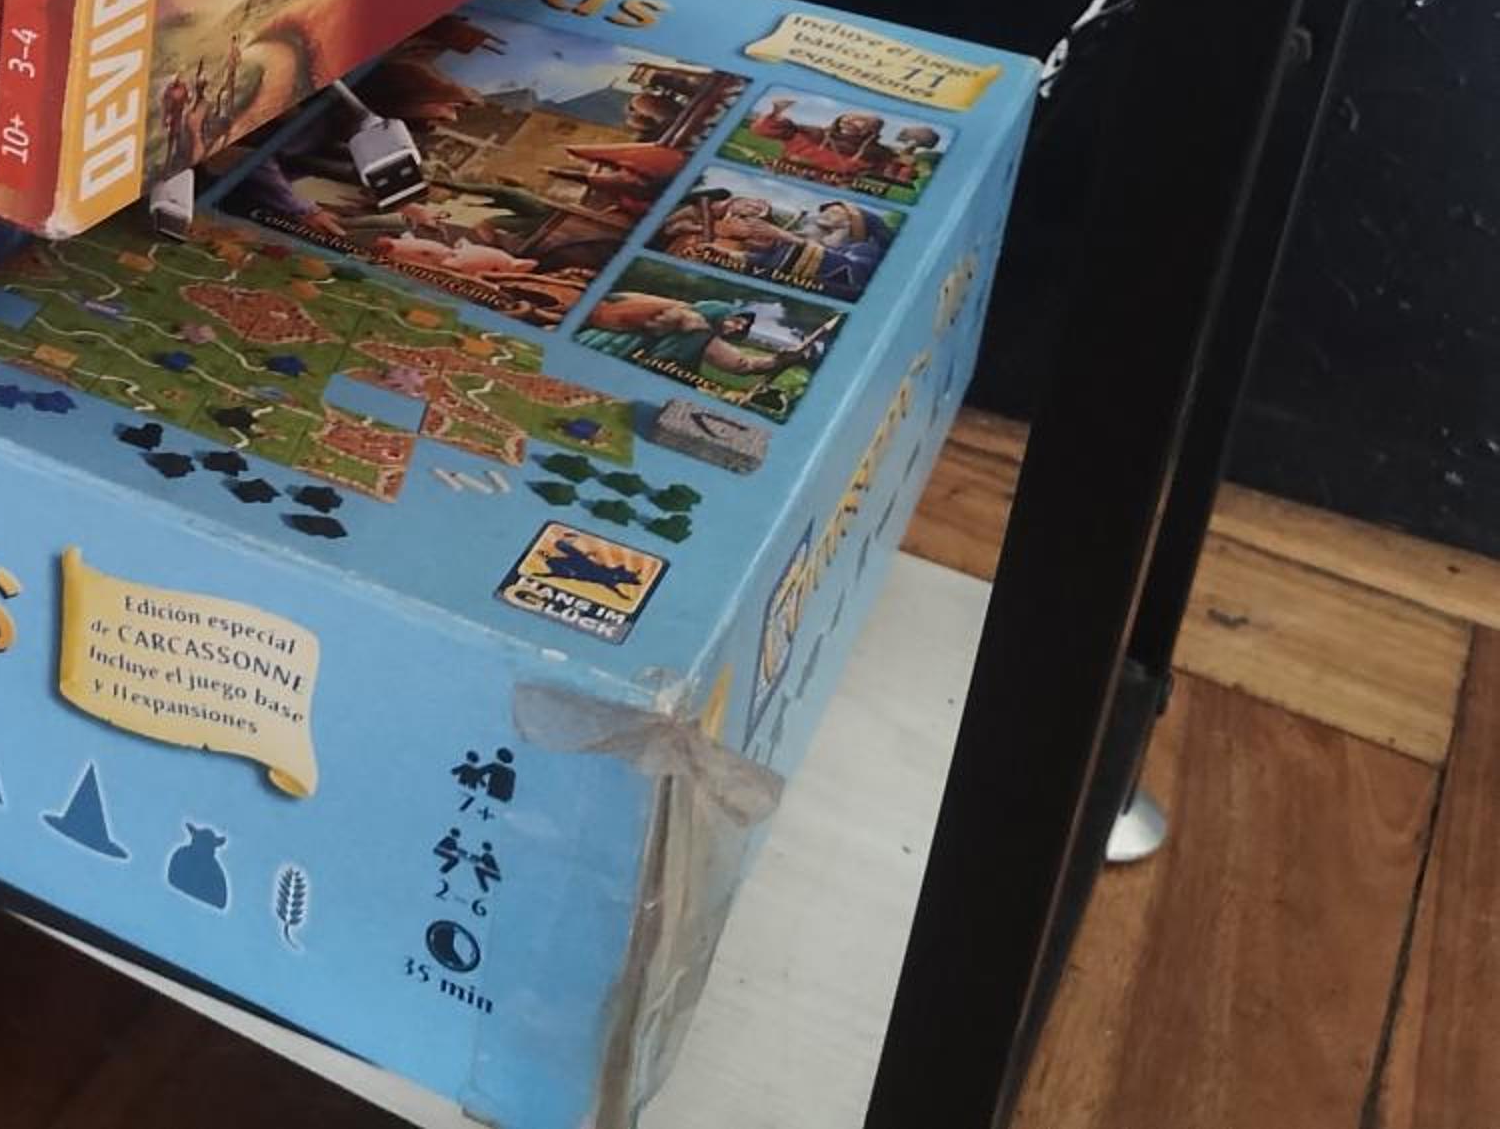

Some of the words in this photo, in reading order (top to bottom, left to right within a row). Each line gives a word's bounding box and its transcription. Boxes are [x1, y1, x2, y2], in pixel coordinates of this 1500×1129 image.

[903, 67, 946, 89] 11
[1, 116, 29, 167] 10+
[124, 594, 201, 626] Edición
[207, 615, 296, 656] especial
[515, 576, 593, 612] HANS
[595, 604, 626, 625] IM
[90, 619, 111, 635] de
[117, 624, 306, 694] CARCASSONNE
[88, 645, 158, 680] Incluye
[164, 667, 183, 685] el
[189, 672, 247, 702] juego
[254, 688, 304, 723] base
[93, 678, 105, 693] y
[113, 683, 128, 701] 11
[130, 690, 259, 735] expansiones
[439, 978, 494, 1014] min
